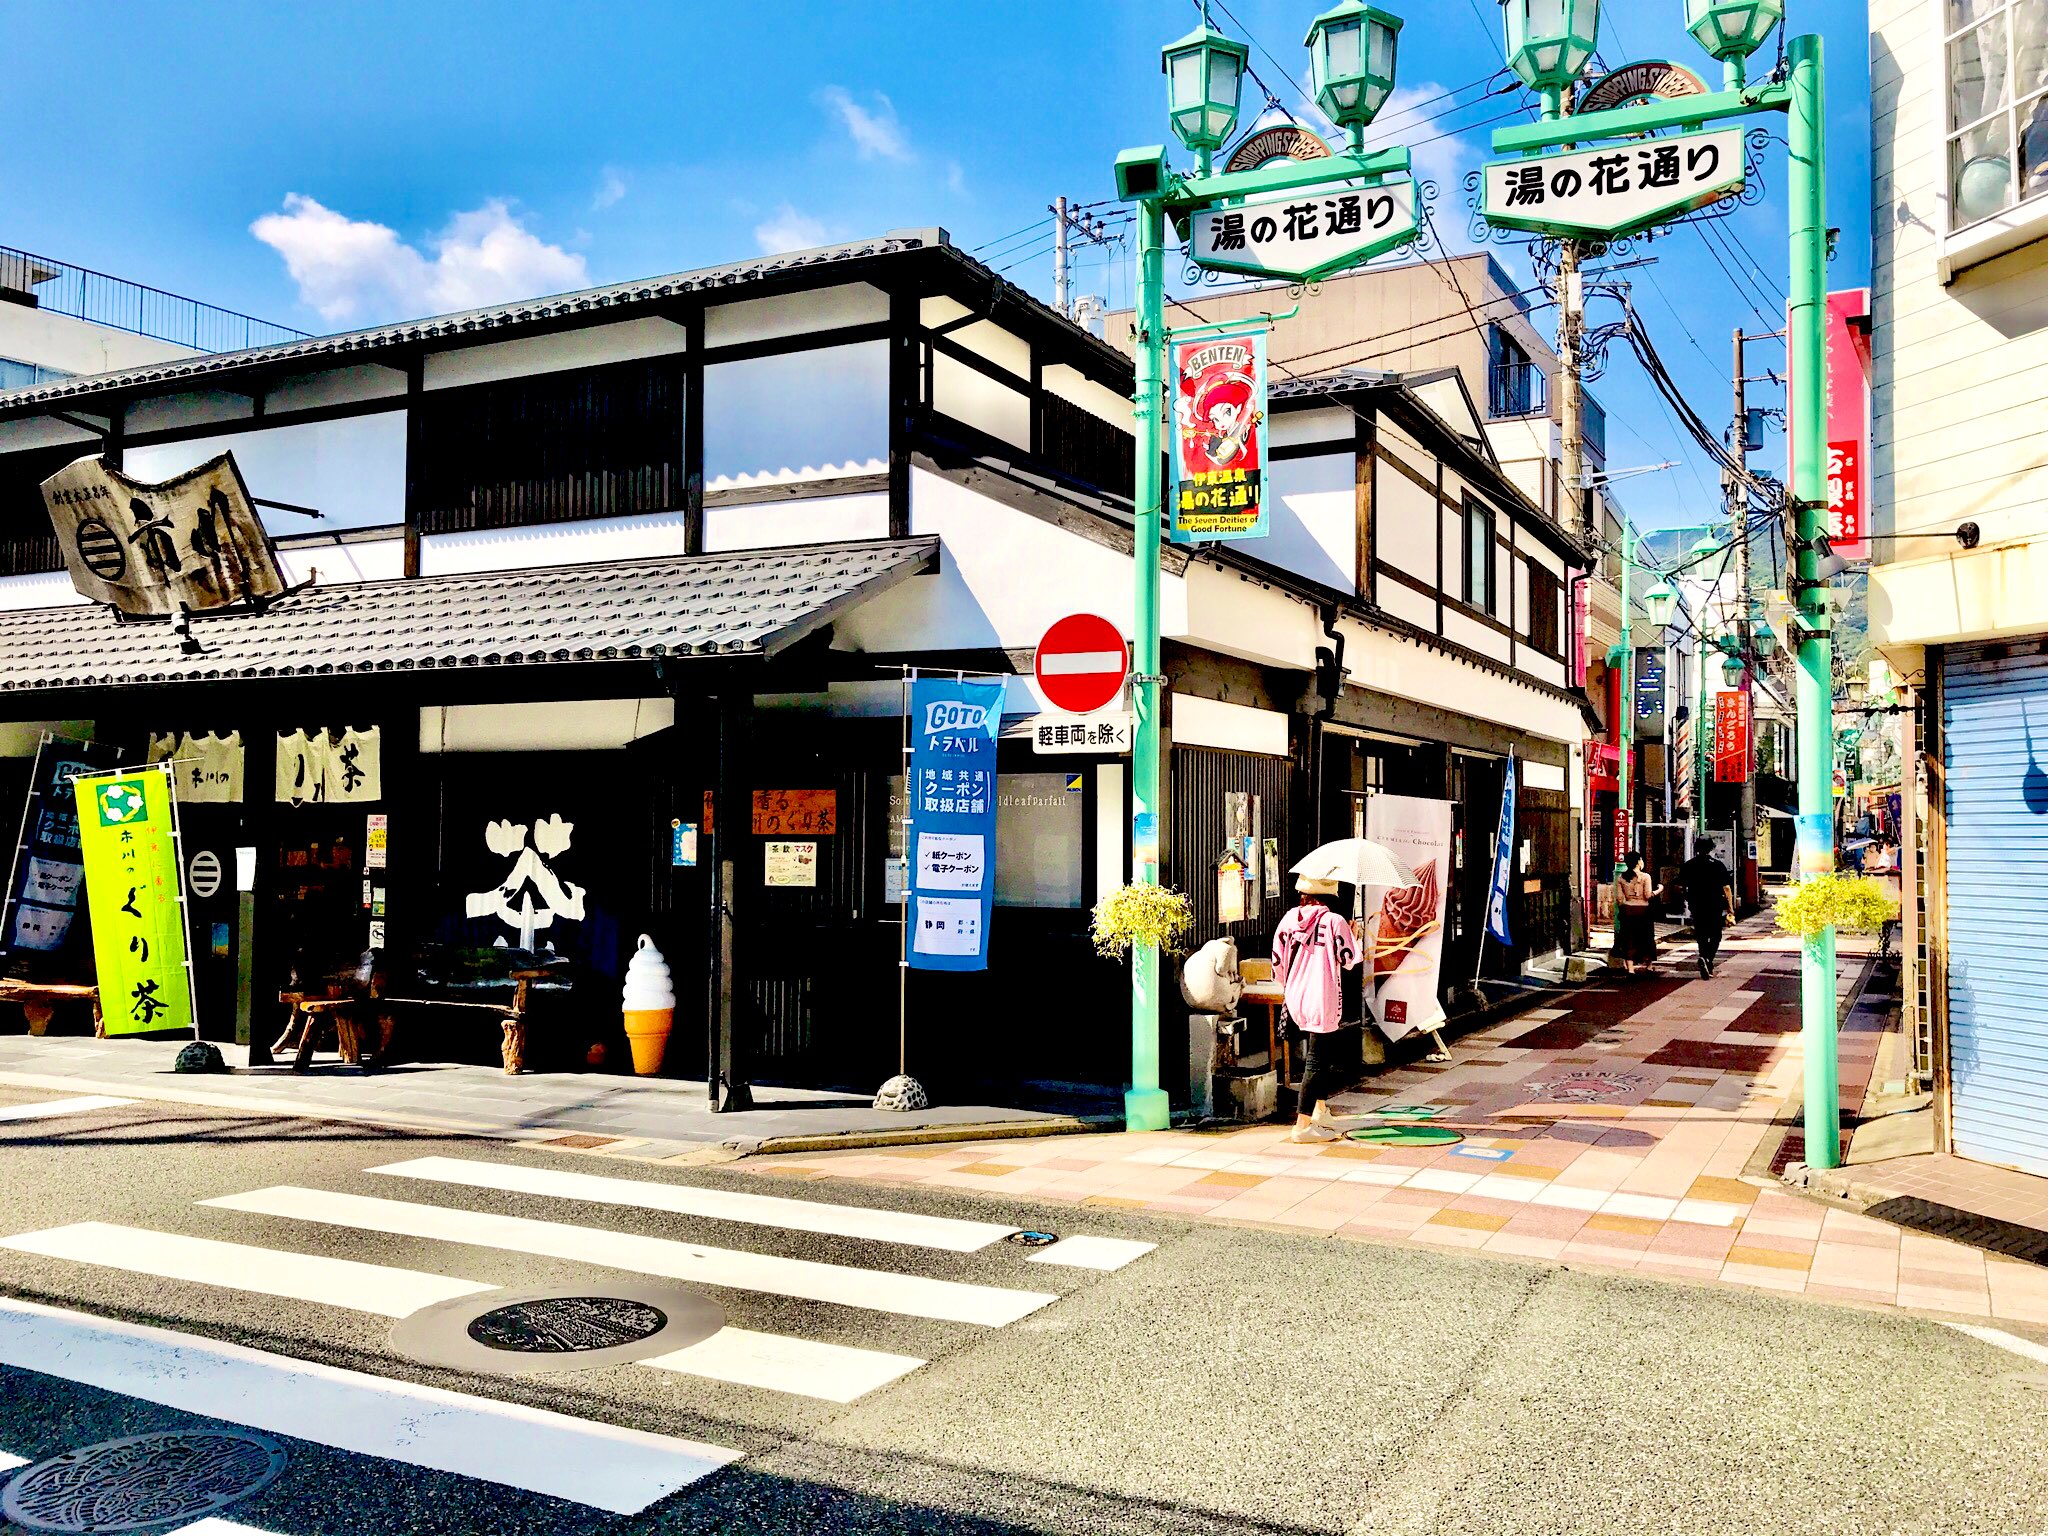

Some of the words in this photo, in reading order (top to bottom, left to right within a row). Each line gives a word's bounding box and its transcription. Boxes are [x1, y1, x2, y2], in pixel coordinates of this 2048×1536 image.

[1504, 143, 1720, 207] 湯の花通り
[1210, 193, 1396, 253] 湯の花通り
[1190, 345, 1244, 372] BENTEN
[1175, 485, 1259, 510] 湯の花通り
[1178, 516, 1192, 525] The
[1194, 516, 1217, 524] Seven
[1219, 515, 1247, 524] Deities
[1250, 515, 1259, 523] of
[1191, 525, 1212, 533] Good
[1214, 524, 1247, 532] Fortune
[1038, 723, 1125, 747] 軽車両を除く
[929, 735, 979, 753] トラベル
[925, 769, 984, 782] 地域共通
[925, 782, 984, 797] クーポン
[924, 797, 985, 814] 取扱店舗
[931, 851, 972, 861] 紙クーポン
[931, 863, 980, 874] 電子クーポン
